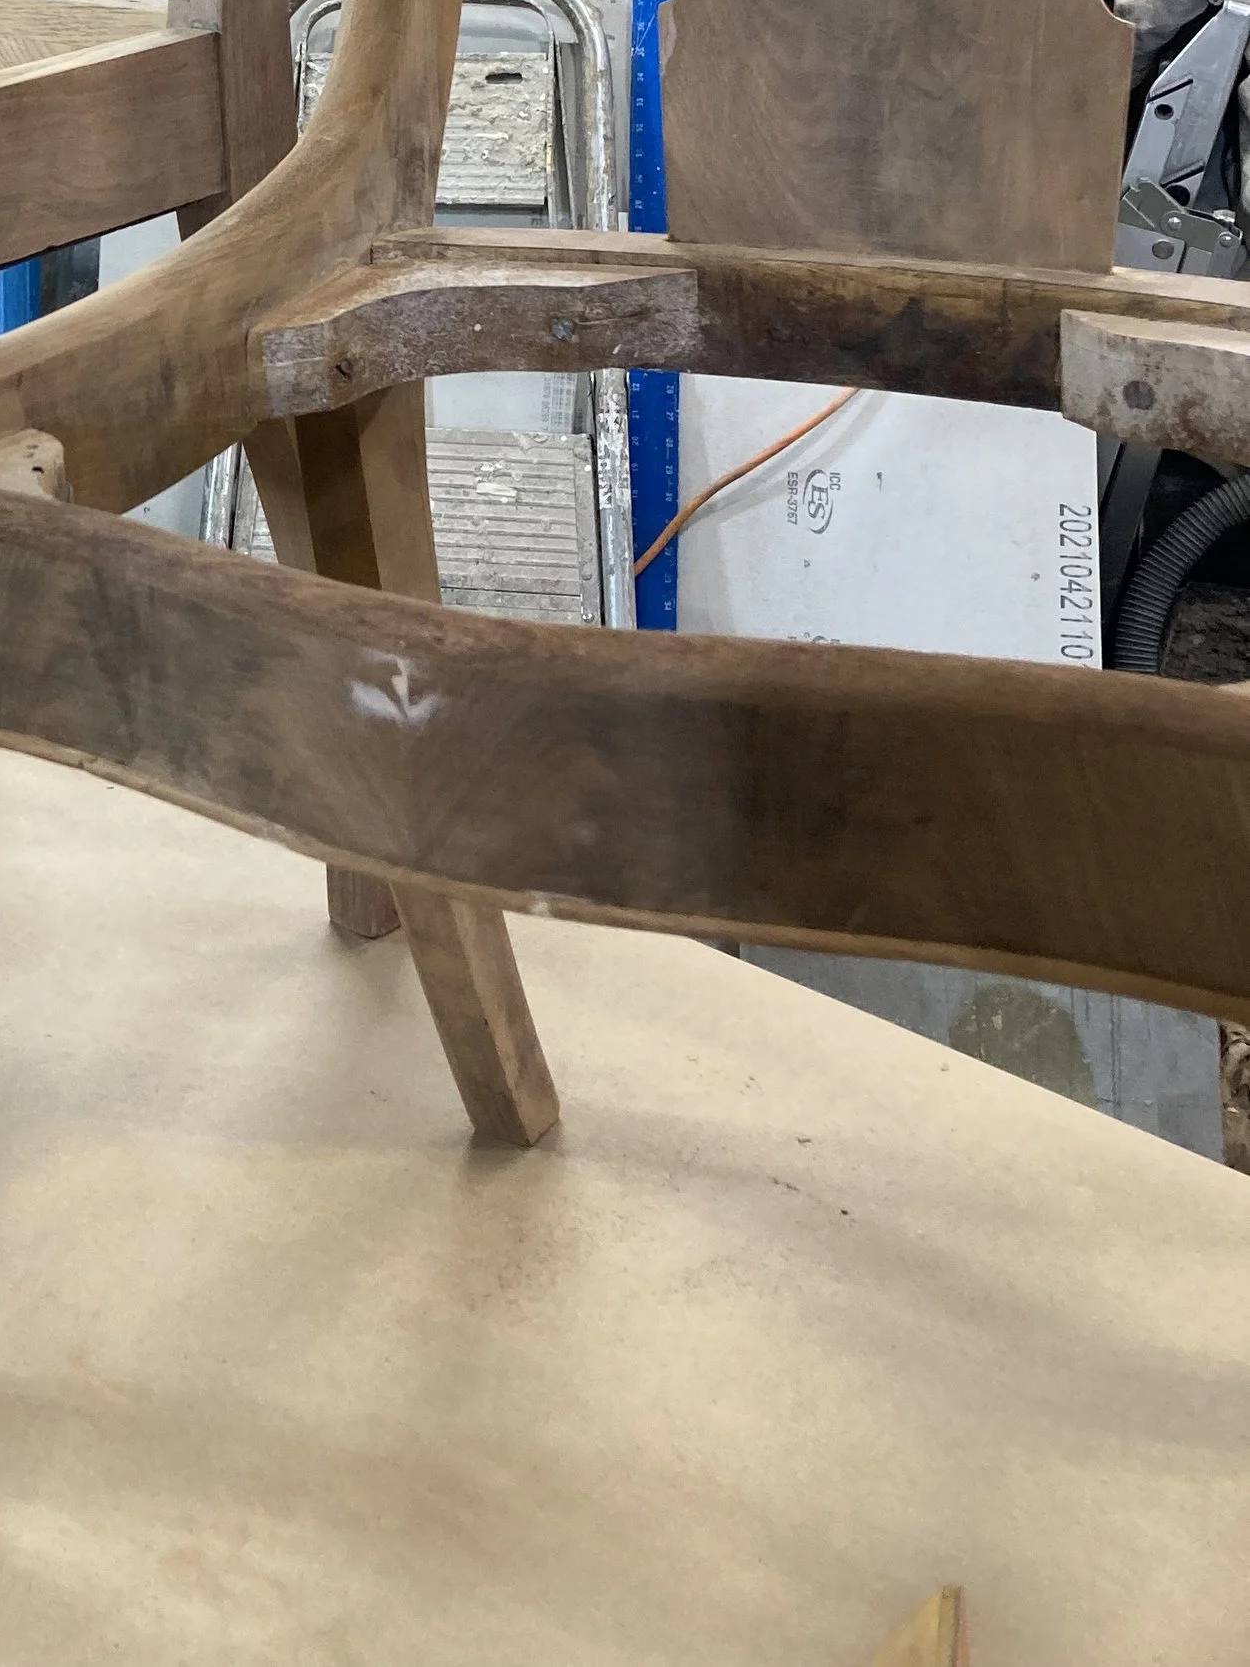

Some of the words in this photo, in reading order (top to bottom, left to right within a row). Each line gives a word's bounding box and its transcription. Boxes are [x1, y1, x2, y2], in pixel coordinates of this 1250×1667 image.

[786, 471, 799, 525] ESR-3767
[807, 484, 829, 520] ES
[829, 471, 842, 491] ICC
[1059, 503, 1094, 667] 2021042110
